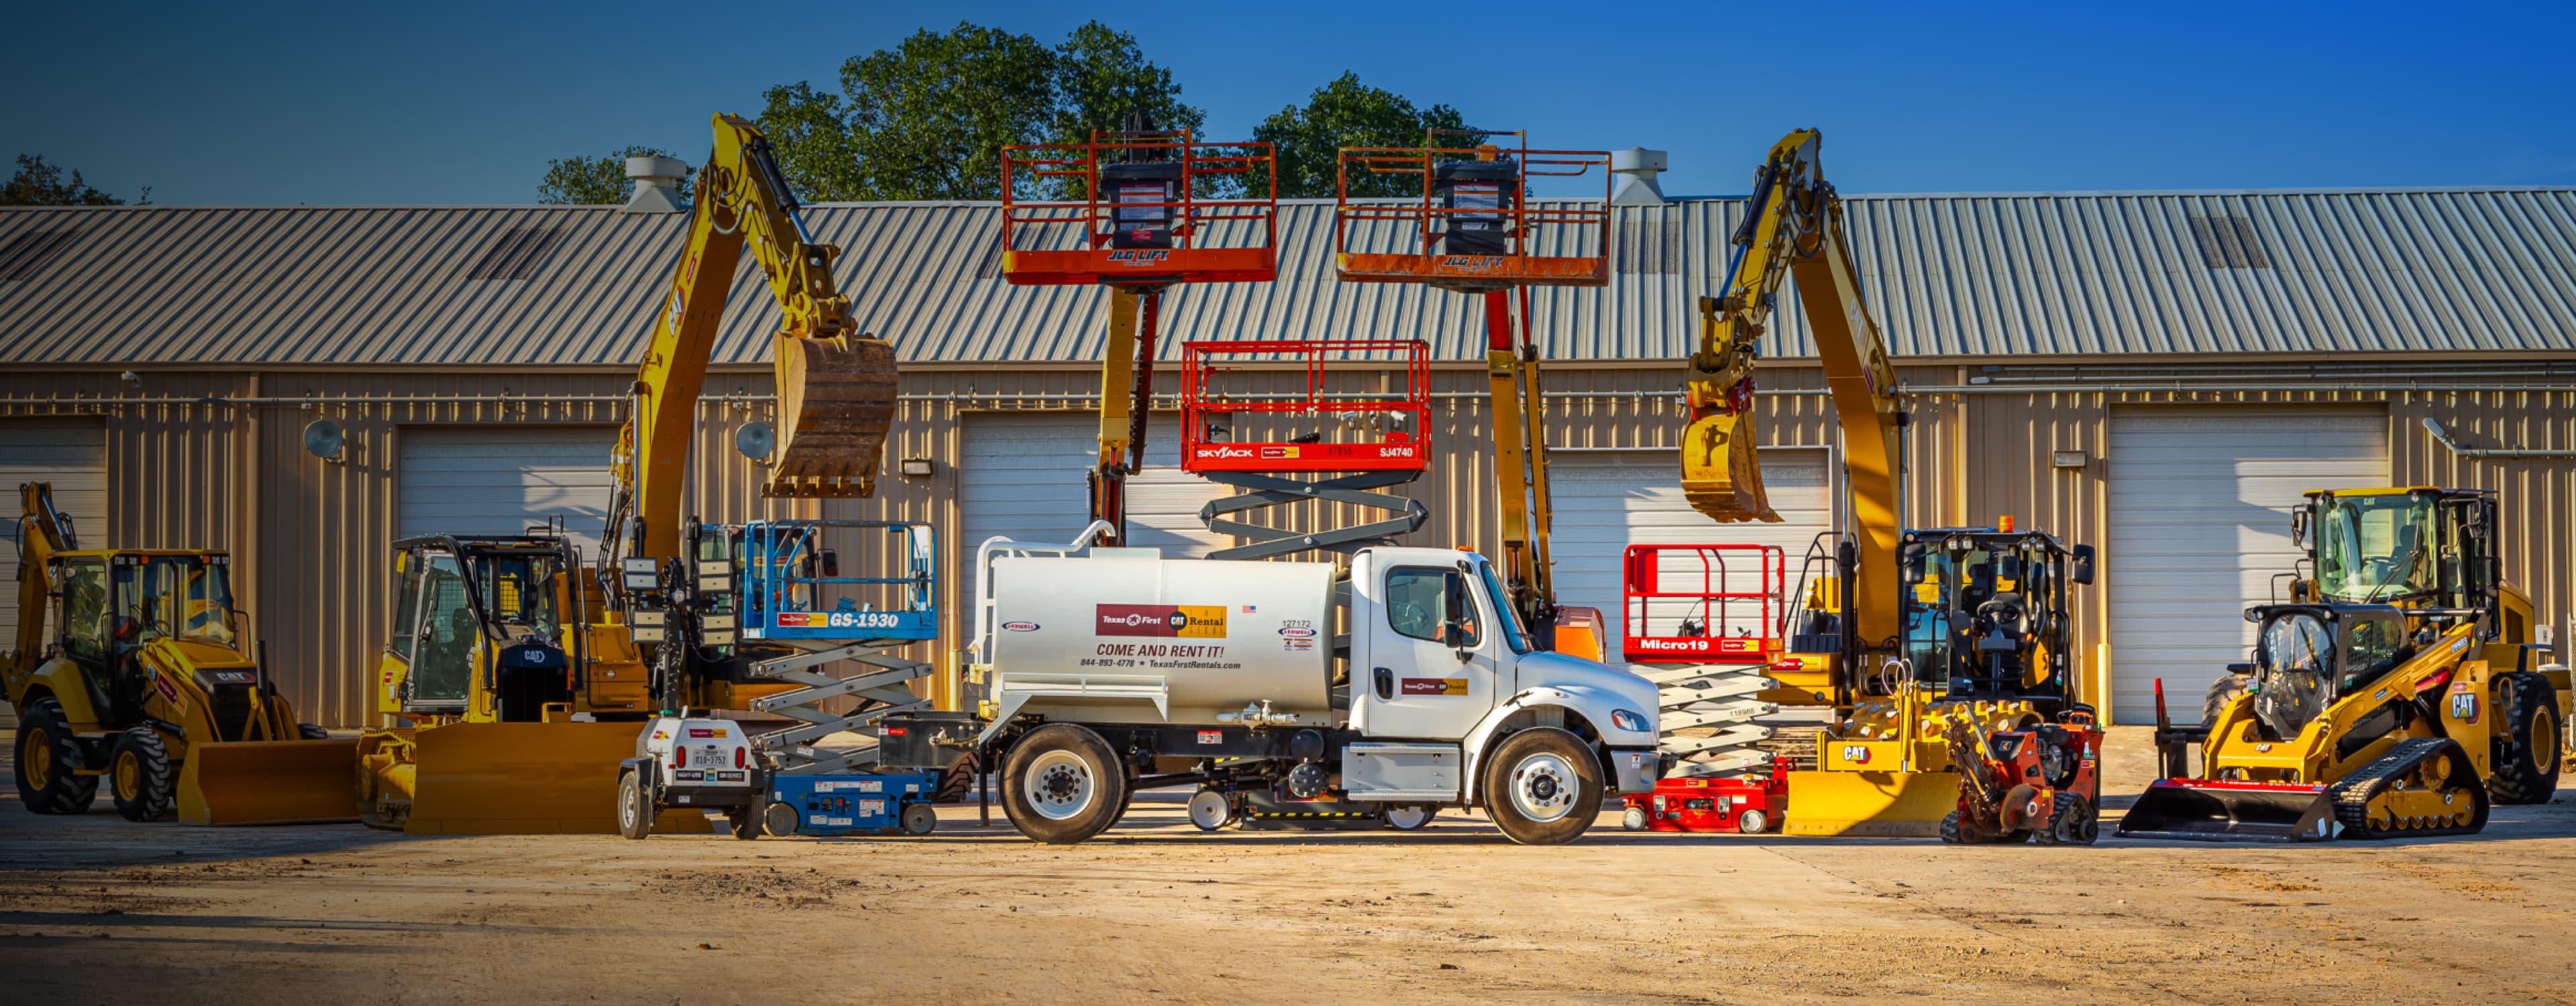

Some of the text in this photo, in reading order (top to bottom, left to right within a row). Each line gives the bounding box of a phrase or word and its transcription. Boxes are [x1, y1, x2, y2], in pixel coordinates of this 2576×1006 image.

[1108, 249, 1170, 261] JLG LIFT
[1443, 256, 1505, 268] JLG LIFT
[667, 289, 682, 337] CAT
[1197, 446, 1253, 459] SKYJACK
[1380, 447, 1413, 457] SJ4740
[2363, 497, 2375, 506] CAT
[830, 613, 899, 628] GS-1930
[1103, 616, 1224, 626] Texas First CAT Rental
[1097, 643, 1224, 658] COME AND RENT IT!
[1641, 640, 1709, 651] Micro19
[525, 651, 539, 659] CAT
[1080, 659, 1241, 669] 844-893-4778 TexasFirstRentals.com
[217, 672, 245, 681] CAT
[2453, 694, 2474, 716] CAT
[1844, 746, 1866, 761] CAT
